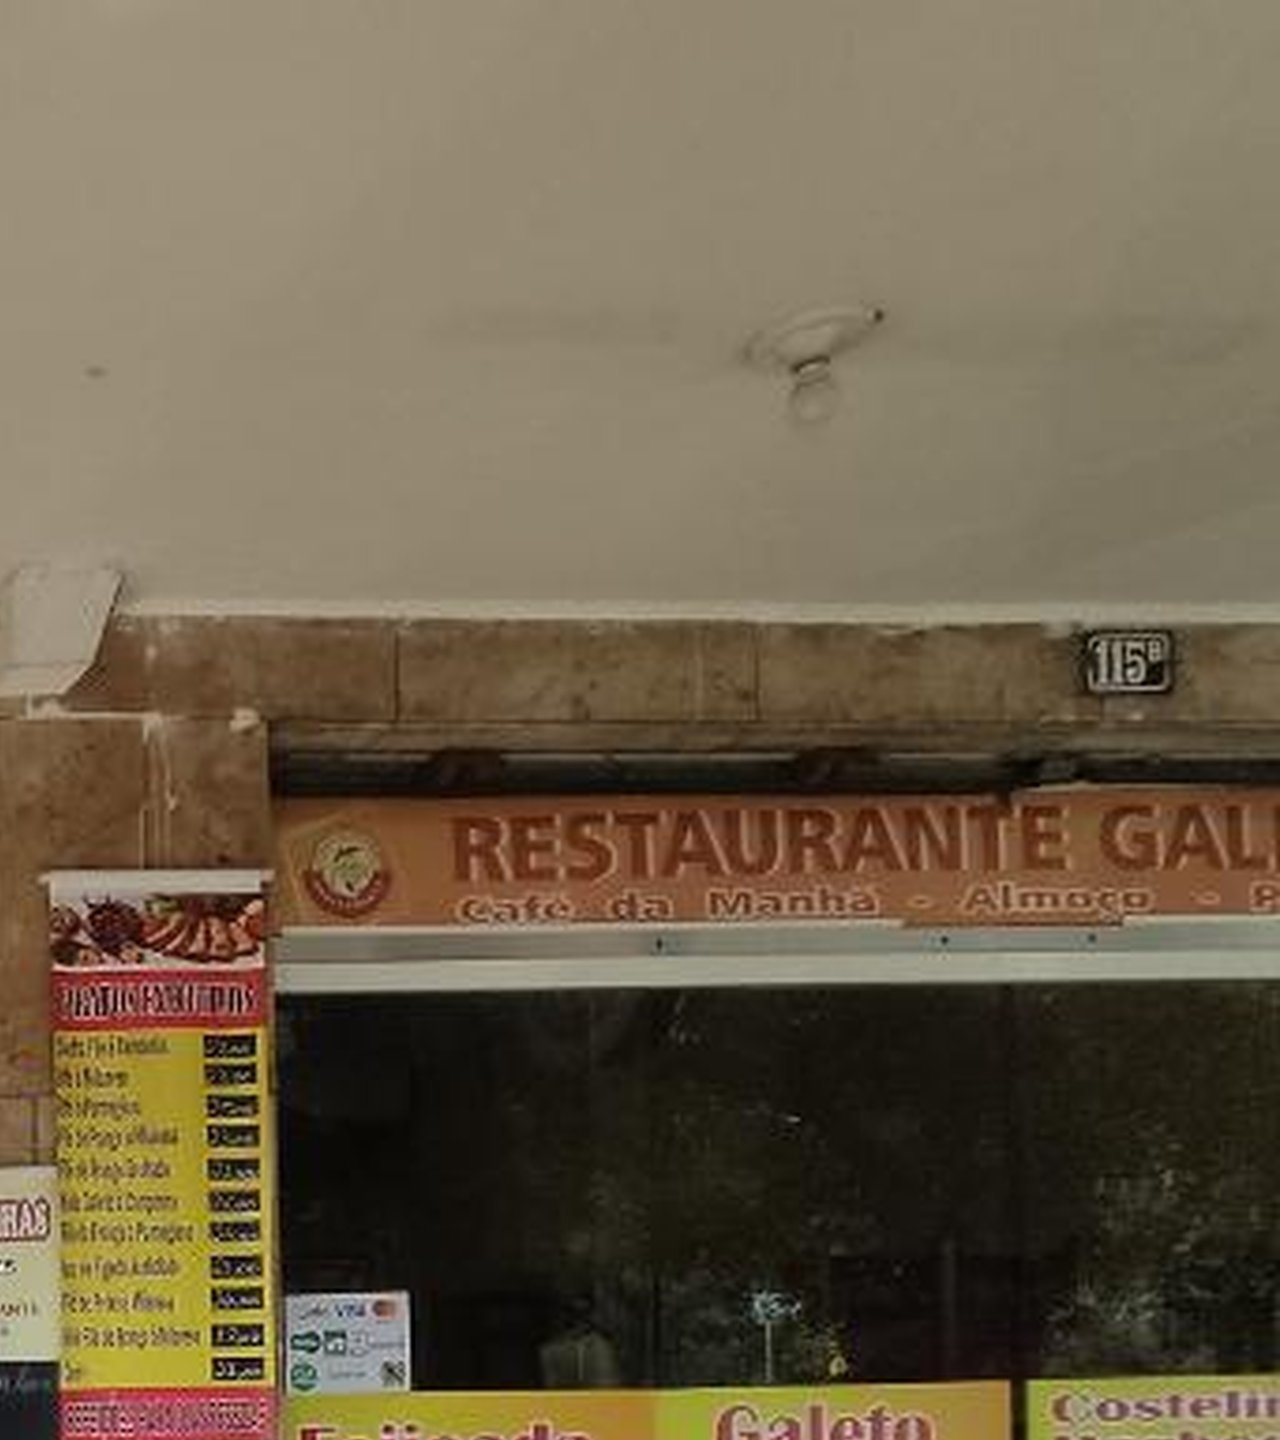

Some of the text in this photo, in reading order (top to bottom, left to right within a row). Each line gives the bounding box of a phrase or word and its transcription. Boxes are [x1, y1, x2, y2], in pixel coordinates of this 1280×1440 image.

[449, 804, 1280, 882] RESTAURANTE GAL
[458, 893, 573, 923] Café
[610, 891, 672, 920] da
[963, 882, 1151, 918] Almoço
